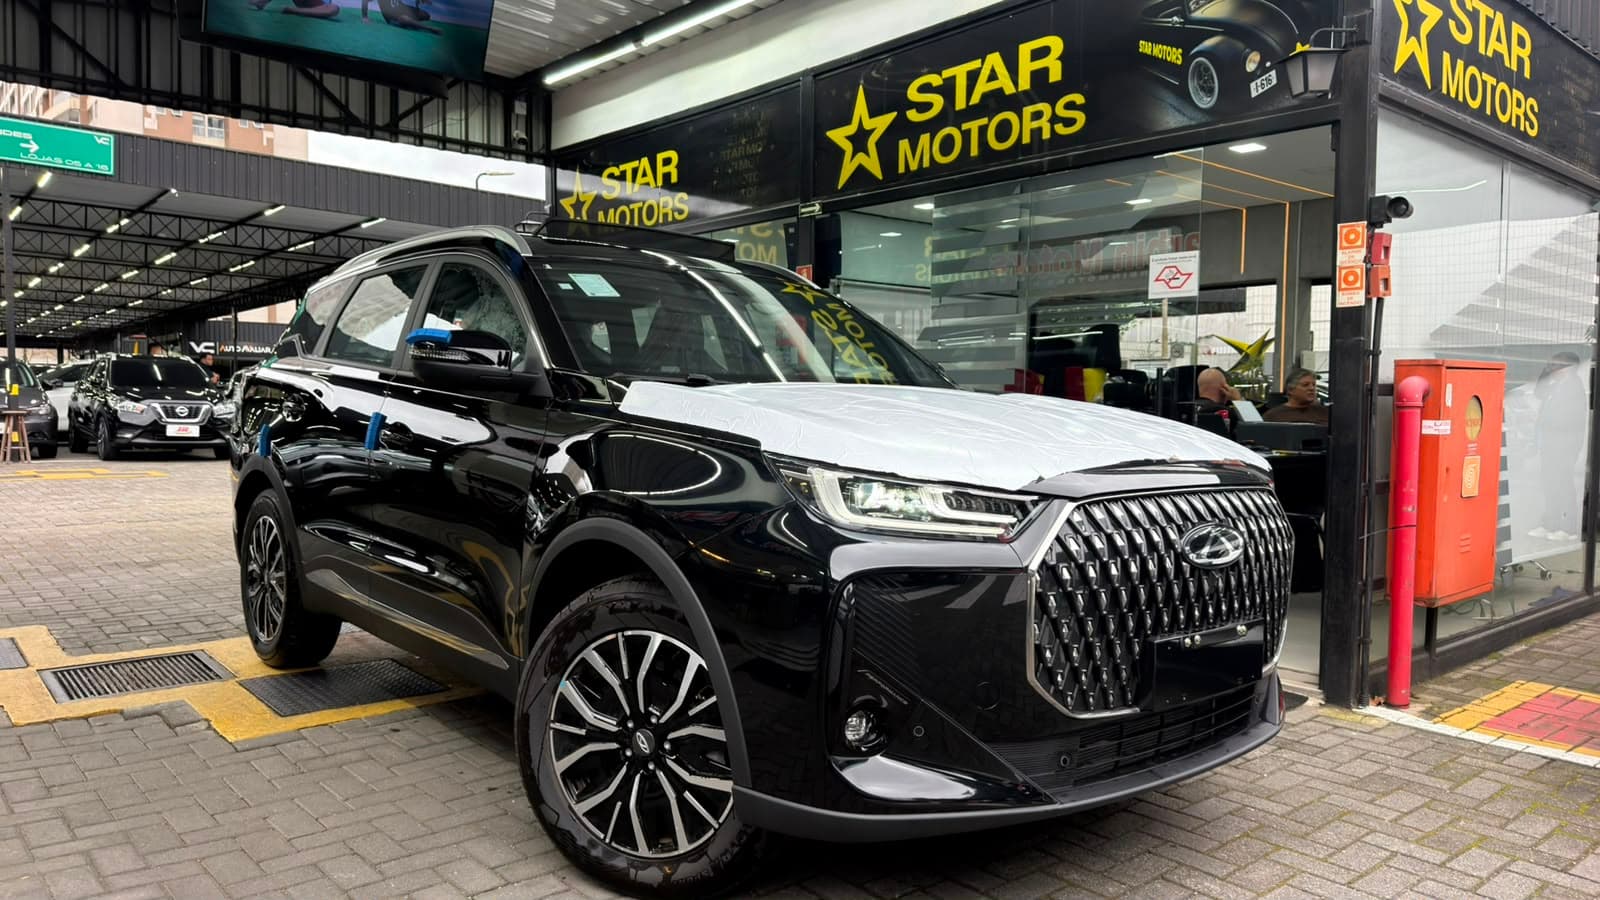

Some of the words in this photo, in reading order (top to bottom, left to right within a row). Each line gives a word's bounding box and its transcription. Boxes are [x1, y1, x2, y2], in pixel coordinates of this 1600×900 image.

[1138, 40, 1152, 55] STAR
[1152, 43, 1183, 65] MOTORS
[1448, 0, 1532, 80] STAR
[905, 35, 1064, 123] STAR
[1441, 50, 1539, 137] MOTORS
[0, 129, 33, 140] DES
[898, 93, 1086, 174] MOTORS
[20, 152, 63, 164] LOJAS
[601, 150, 679, 200] STAR
[598, 192, 689, 227] MOTORS
[189, 341, 216, 354] VC
